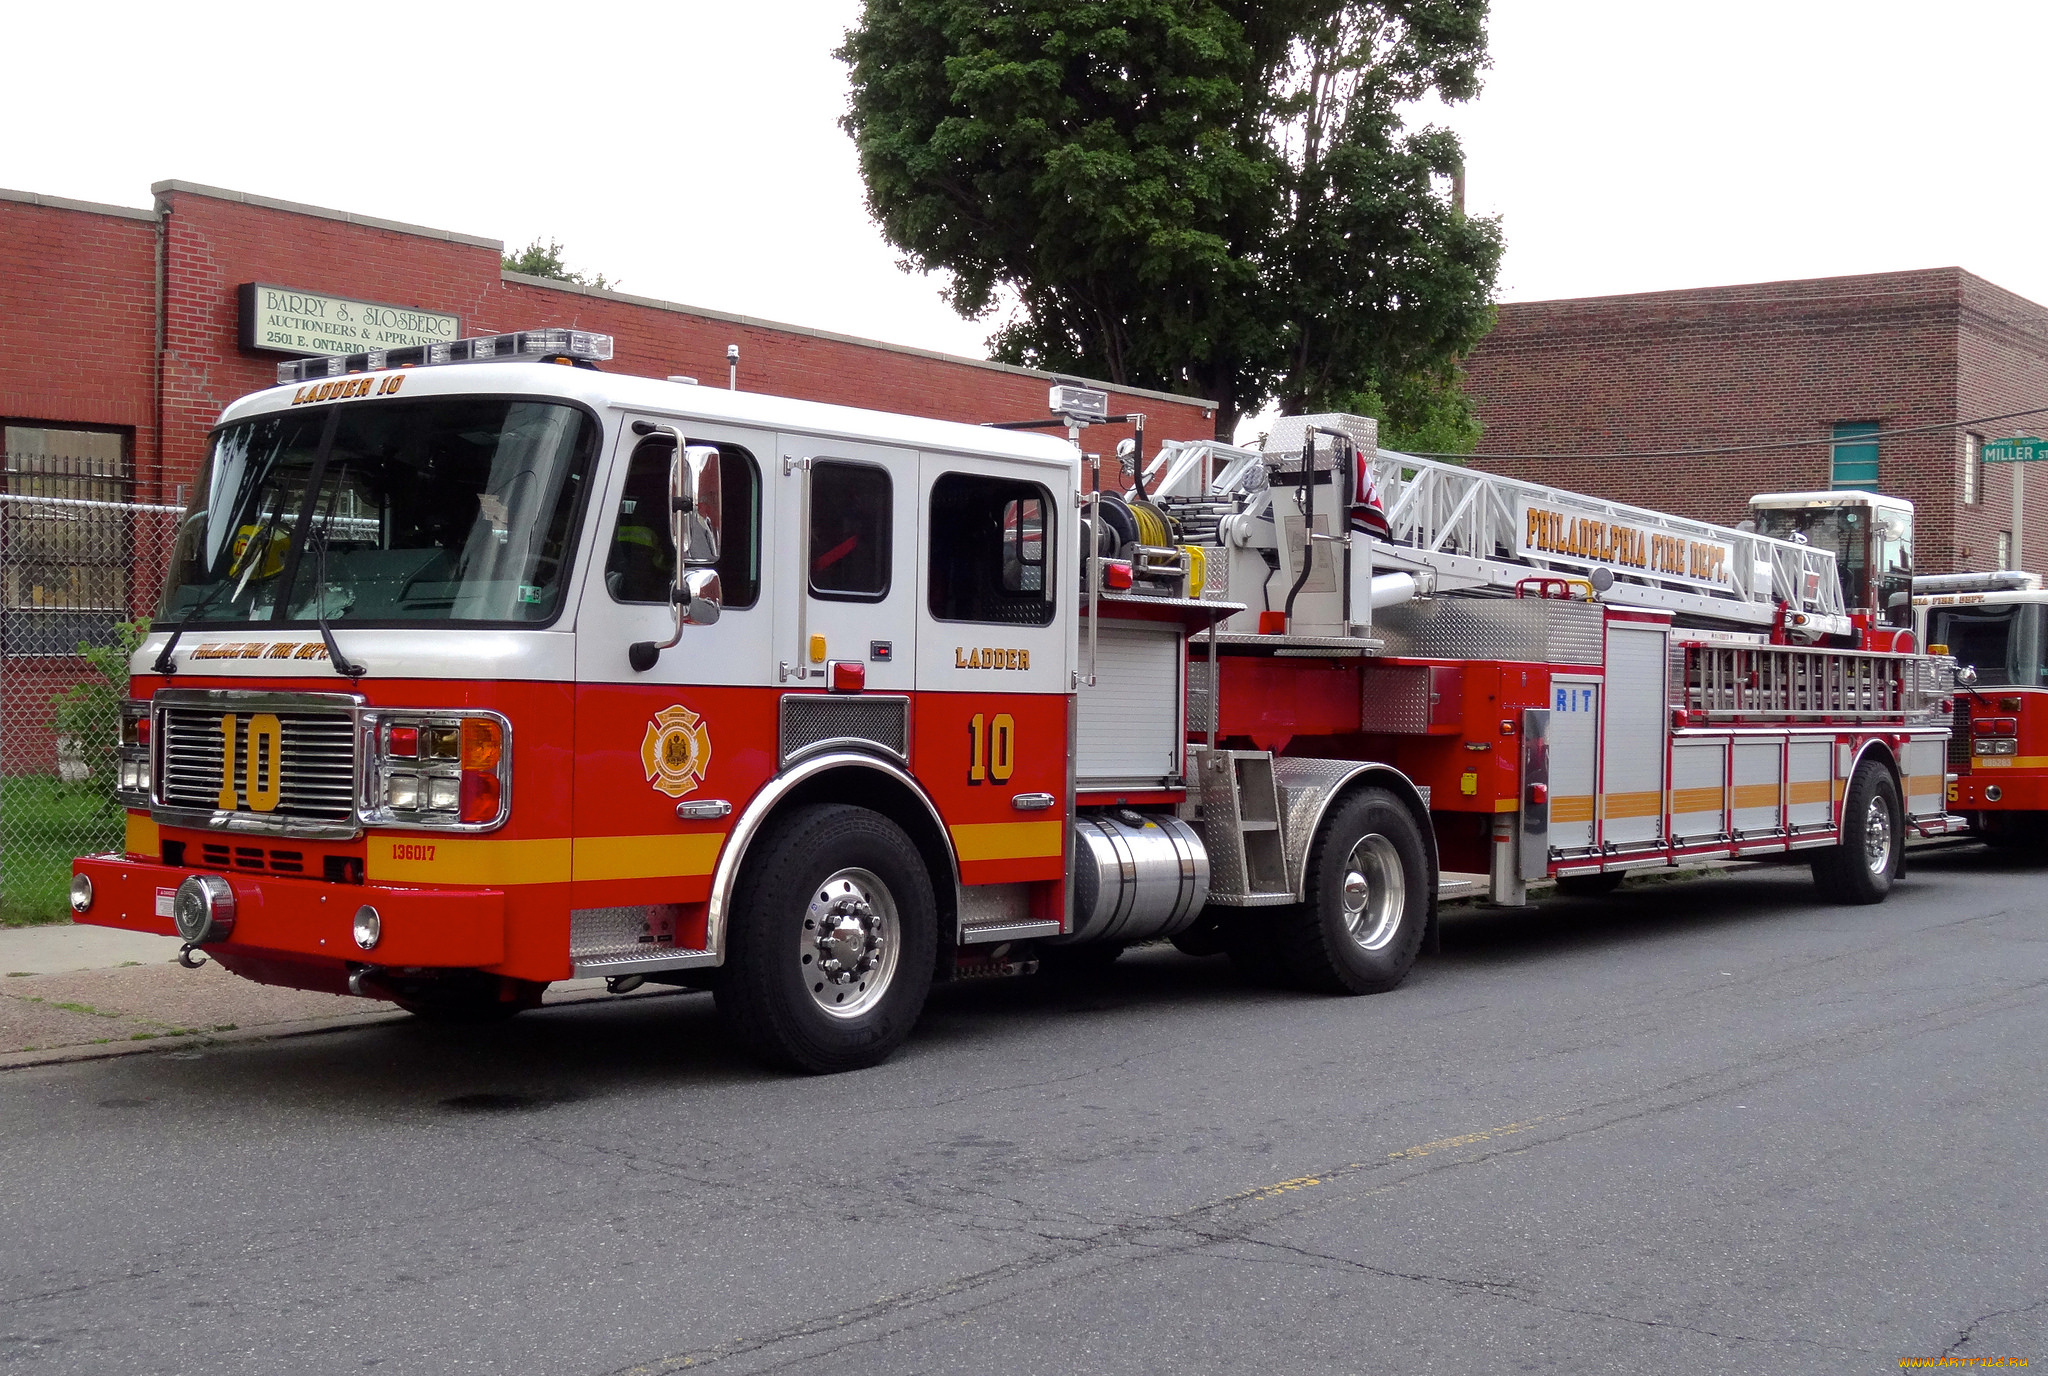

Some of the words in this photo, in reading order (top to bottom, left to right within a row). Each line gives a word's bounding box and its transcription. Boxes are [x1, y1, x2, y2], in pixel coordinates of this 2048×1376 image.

[266, 291, 328, 318] BARRY
[336, 303, 354, 322] S.
[362, 307, 452, 337] SLOSBERG
[266, 314, 357, 338] AUCTIONEERS
[360, 328, 371, 340] &
[266, 331, 293, 345] 2501
[297, 335, 309, 348] E.
[312, 338, 365, 354] ONTARIO
[291, 377, 375, 406] LADDER
[377, 374, 406, 396] 10
[1985, 446, 2033, 461] MILLER
[1526, 507, 1647, 569] PHILADELPHIA
[1651, 533, 1686, 576] FIRE
[1689, 541, 1729, 584] DEPT.
[955, 647, 1031, 671] LADDER
[1556, 688, 1592, 713] RIT
[967, 713, 1015, 786] 10
[218, 713, 282, 812] 10
[1947, 783, 1959, 801] 5
[392, 843, 436, 861] 136017
